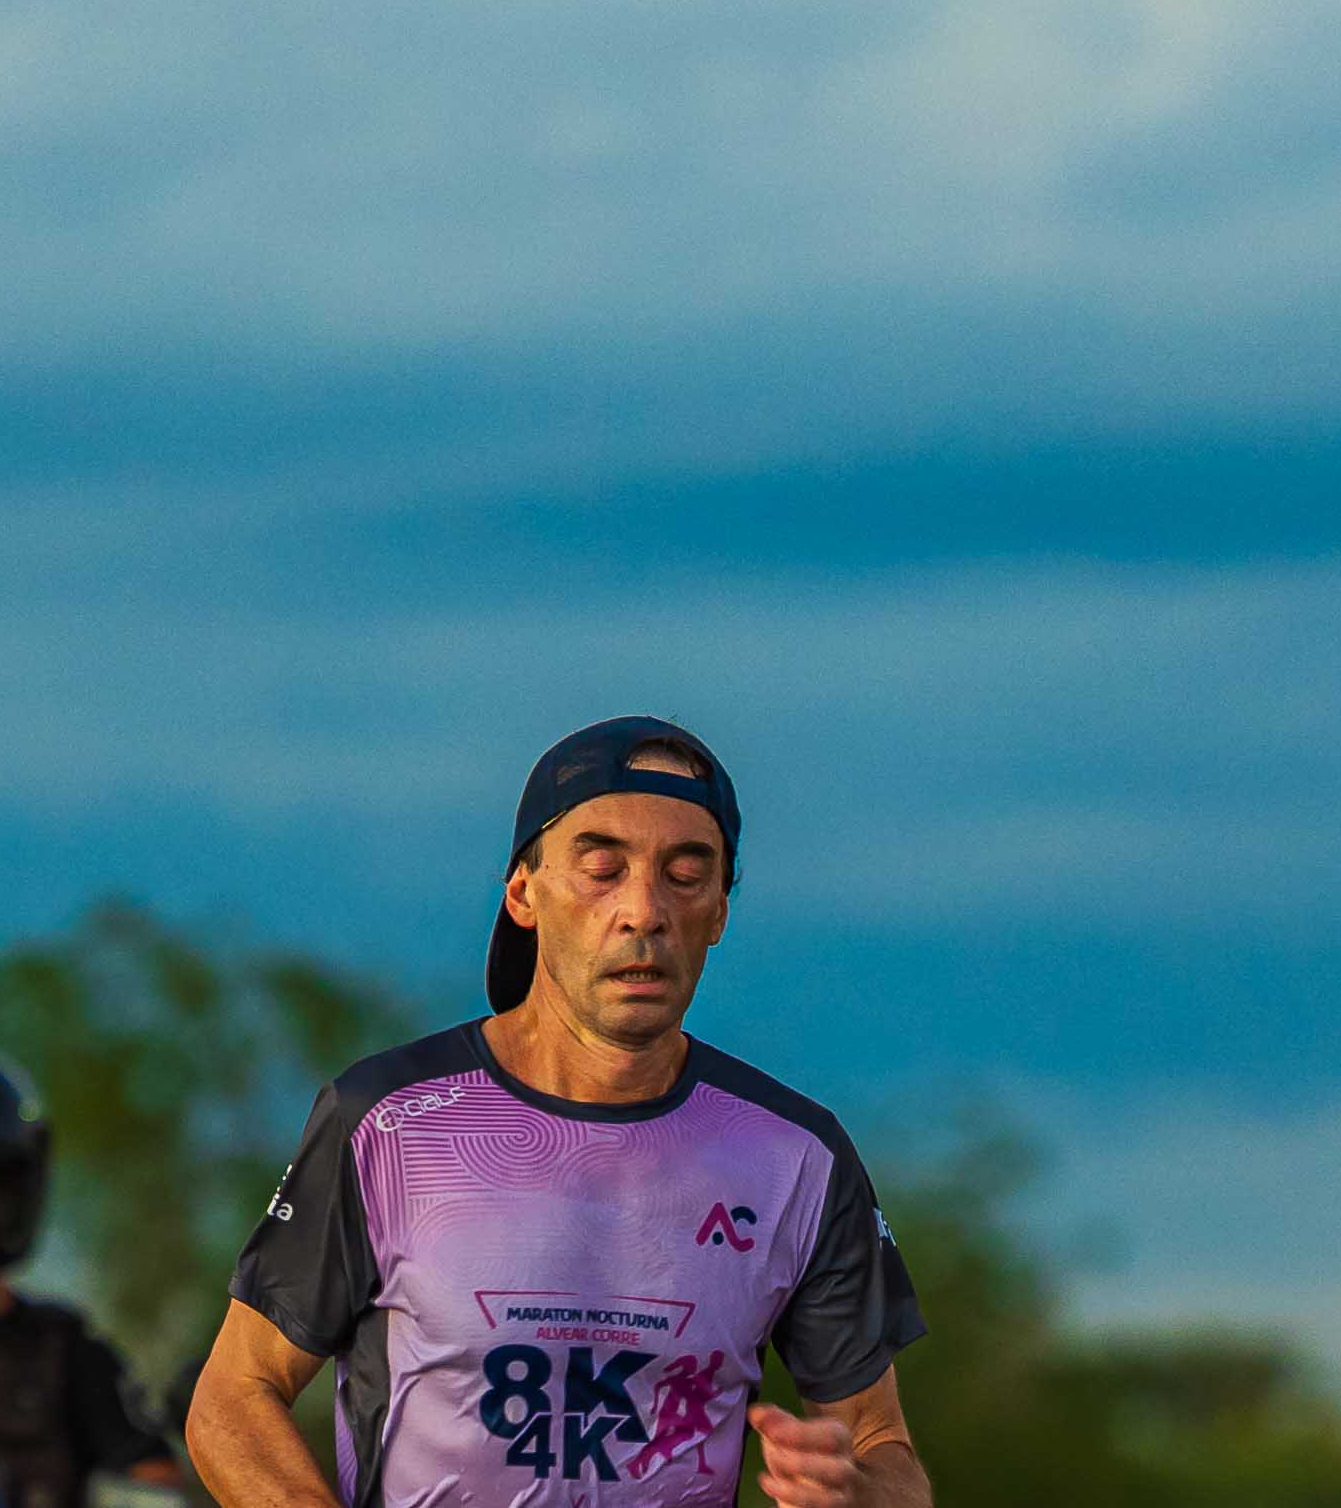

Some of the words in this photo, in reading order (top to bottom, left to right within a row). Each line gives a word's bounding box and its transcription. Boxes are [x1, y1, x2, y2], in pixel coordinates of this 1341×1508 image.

[506, 1306, 582, 1322] MARATON
[585, 1309, 669, 1331] NOCTURNA
[536, 1327, 589, 1341] ALVEAR
[592, 1328, 641, 1346] CORRE
[479, 1344, 660, 1444] 8K
[505, 1414, 622, 1482] 4K
